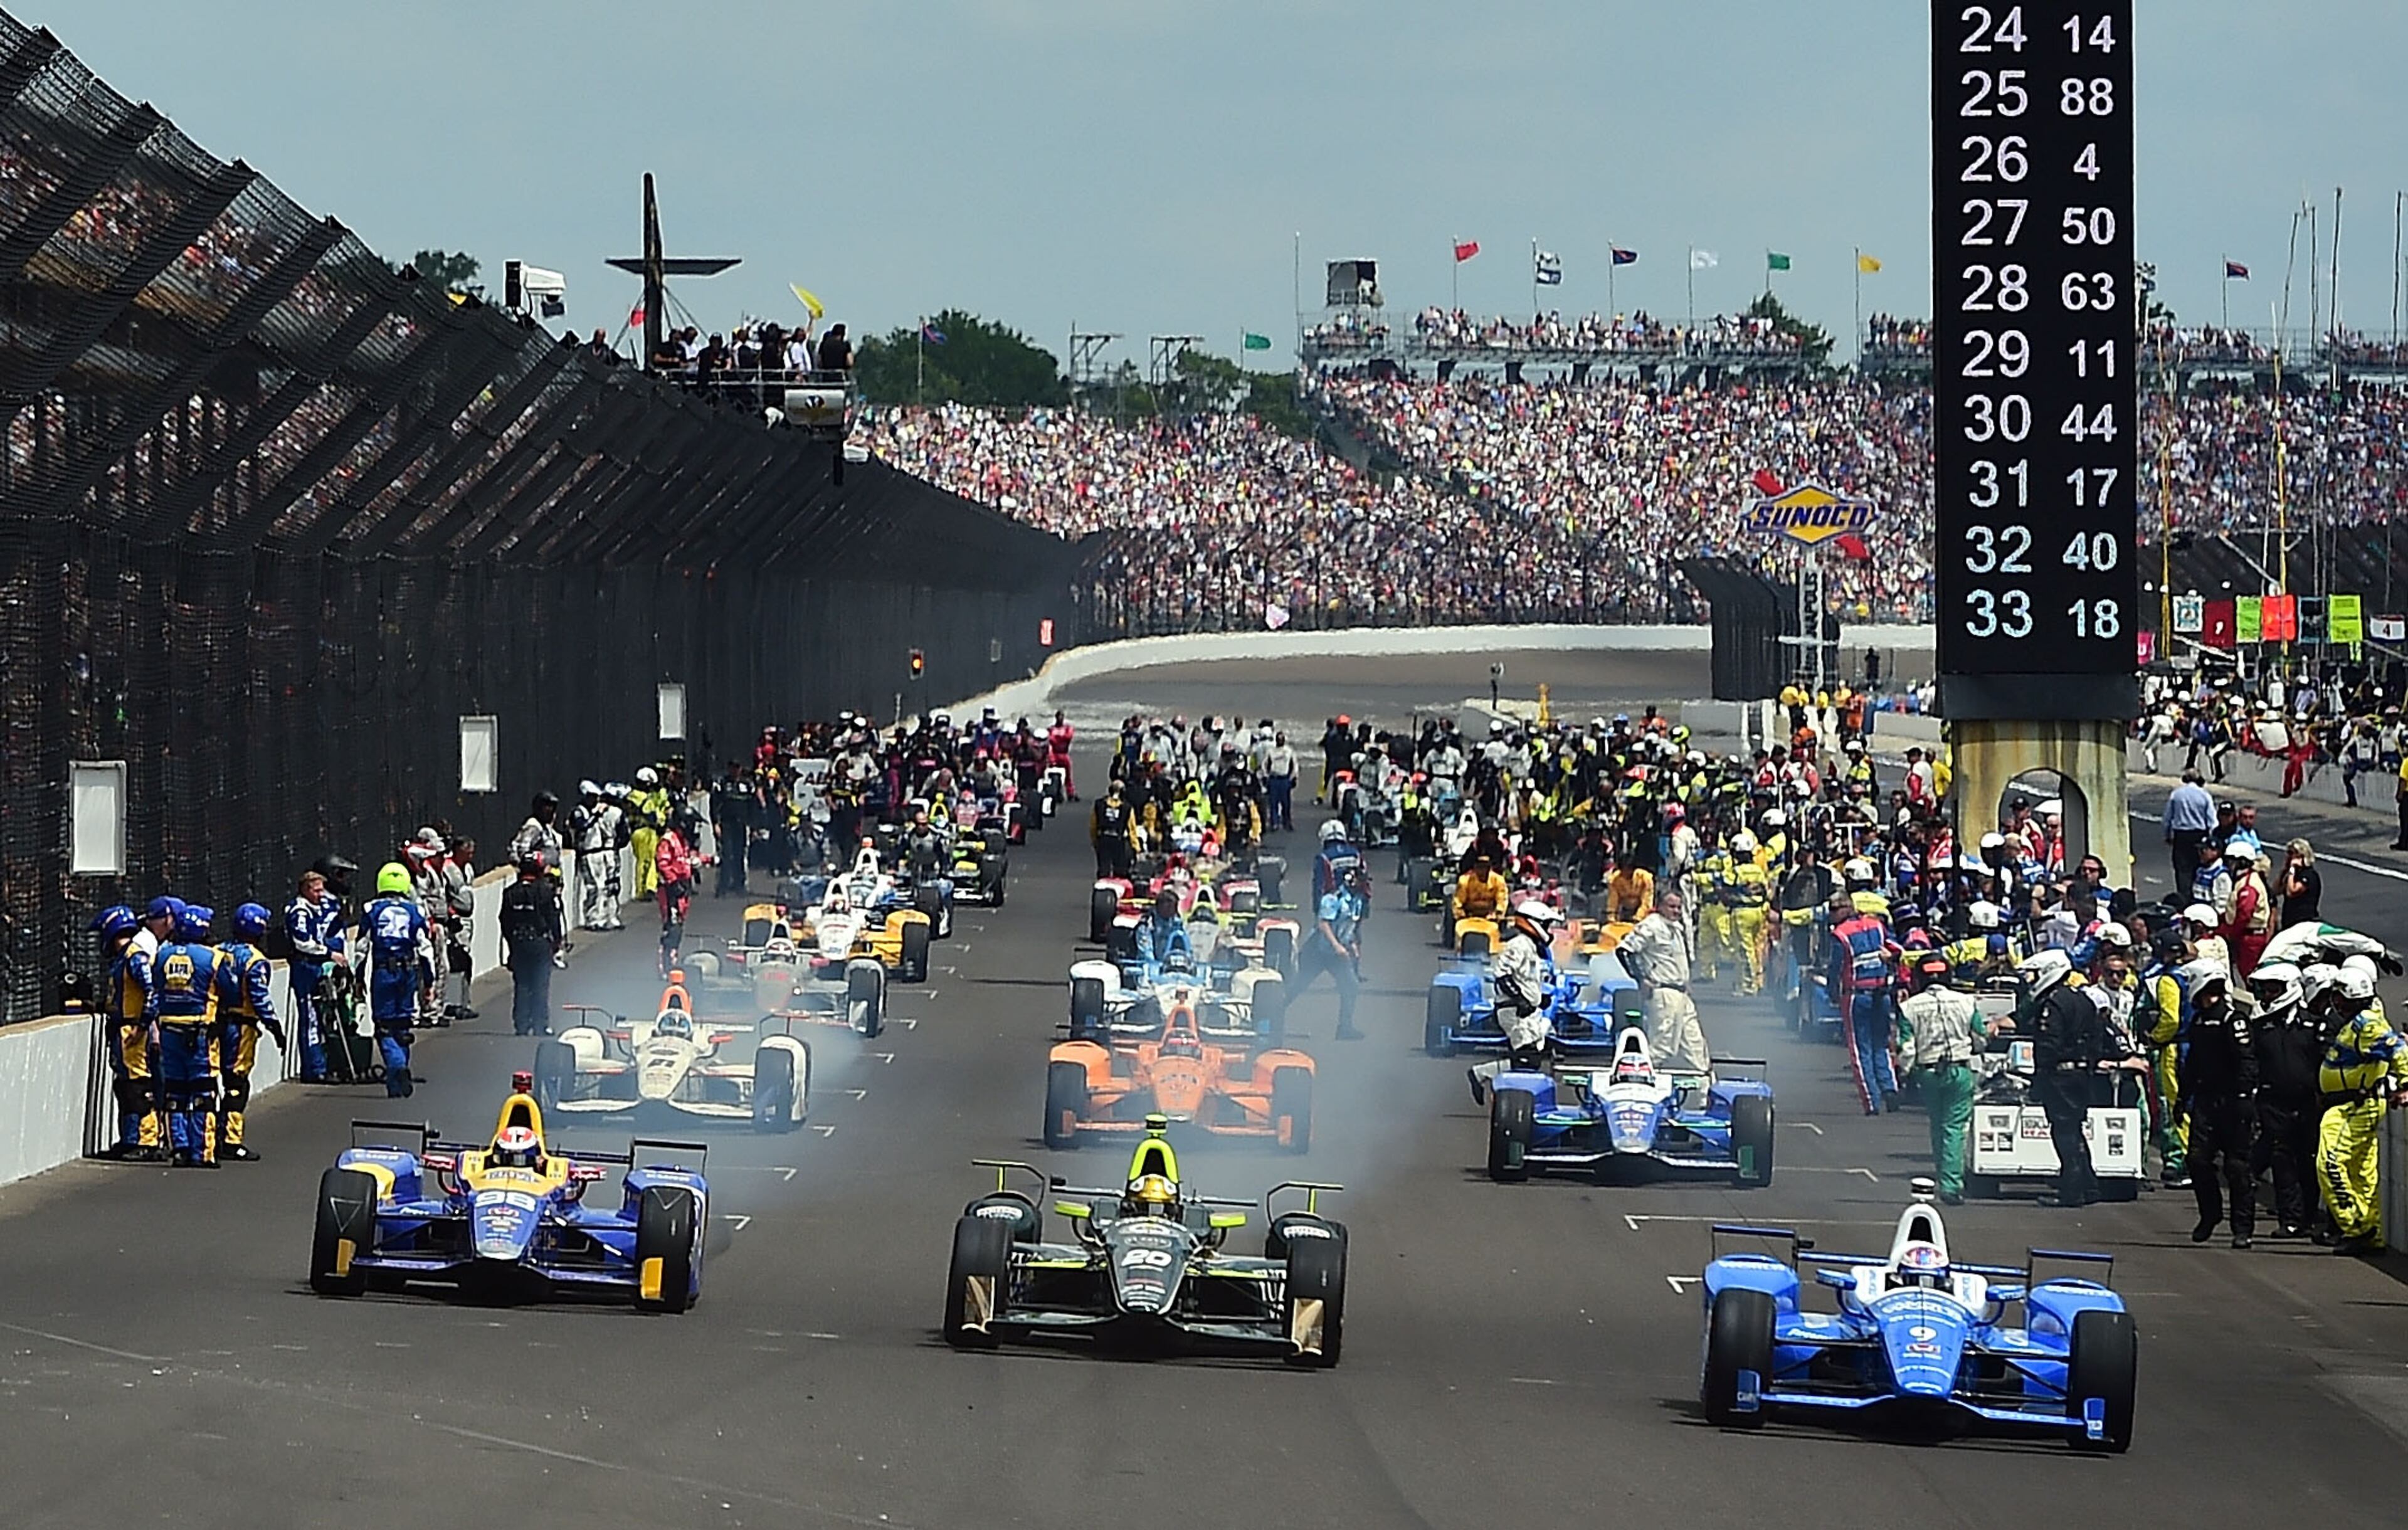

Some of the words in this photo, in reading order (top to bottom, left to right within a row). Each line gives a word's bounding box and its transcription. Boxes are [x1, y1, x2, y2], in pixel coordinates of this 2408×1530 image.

[1960, 6, 2027, 51] 24
[2063, 15, 2115, 53] 14
[1961, 70, 2027, 116] 25
[2061, 78, 2115, 115] 88
[1961, 136, 2027, 181] 26
[2074, 144, 2100, 181] 4
[1962, 199, 2028, 245] 27
[2063, 208, 2115, 245] 50
[1962, 265, 2029, 311] 28
[2062, 273, 2115, 310] 63
[1962, 330, 2029, 377] 29
[2069, 340, 2115, 377] 11
[1965, 394, 2031, 441] 30
[2061, 404, 2117, 441] 44
[1970, 459, 2027, 507] 31
[2067, 468, 2117, 506] 17
[1755, 505, 1869, 527] SUNOCO
[1966, 526, 2031, 572] 32
[2063, 532, 2117, 571] 40
[1967, 589, 2032, 637] 33
[2068, 599, 2119, 638] 18
[1121, 1249, 1172, 1267] 20
[1908, 1326, 1937, 1343] 9
